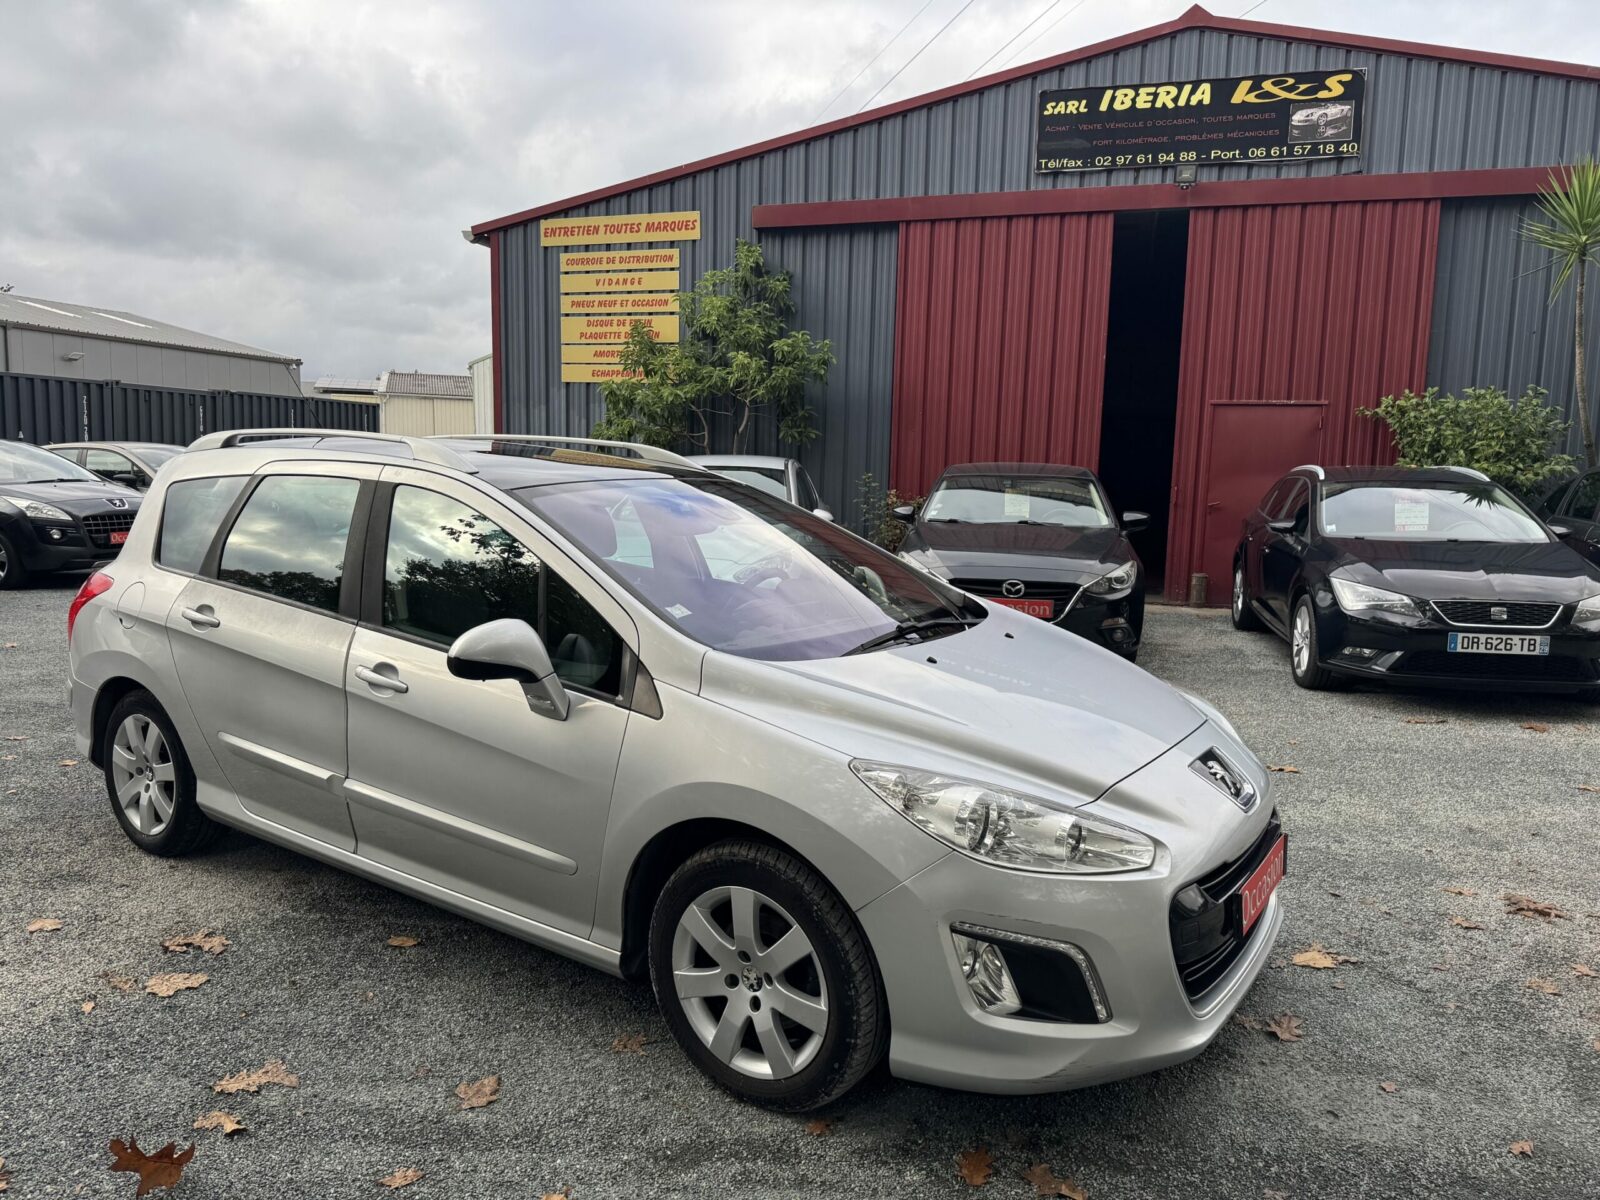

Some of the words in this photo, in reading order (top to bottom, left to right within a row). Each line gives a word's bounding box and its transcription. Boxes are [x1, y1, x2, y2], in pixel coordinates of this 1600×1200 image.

[1043, 99, 1088, 116] SARL
[1099, 82, 1212, 111] IBERIA
[1045, 124, 1069, 132] ACHAT
[1079, 123, 1102, 131] VENTE
[1203, 114, 1233, 123] TOUTES
[1236, 112, 1276, 121] MARQUES
[1227, 128, 1280, 139] MÉCANIQUES
[1039, 157, 1083, 169] Tél/fax
[1095, 156, 1112, 166] 02
[1115, 154, 1133, 165] 97
[1137, 153, 1152, 164] 61
[1158, 152, 1175, 162] 94
[1179, 151, 1197, 161] 88
[1211, 149, 1243, 160] Port.
[1248, 147, 1266, 158] 06
[1270, 146, 1287, 156] 61
[1293, 144, 1312, 155] 57
[1317, 143, 1335, 154] 18
[1338, 142, 1358, 153] 40
[543, 224, 600, 238] ENTRETIEN
[603, 221, 642, 235] TOUTES
[645, 219, 698, 233] MARQUES
[565, 256, 604, 266] COURROIE
[606, 256, 617, 265] DE
[618, 254, 674, 264] DISTRIBUTION
[570, 299, 596, 309] PNEUS
[597, 299, 618, 308] NEUF
[620, 299, 629, 308] ET
[631, 298, 669, 308] OCCASION
[586, 319, 614, 328] DISQUE
[616, 319, 627, 327] DE
[579, 331, 622, 340] PLAQUETTE
[1461, 635, 1537, 652] DR-626-TB
[1241, 850, 1284, 925] Occasion
